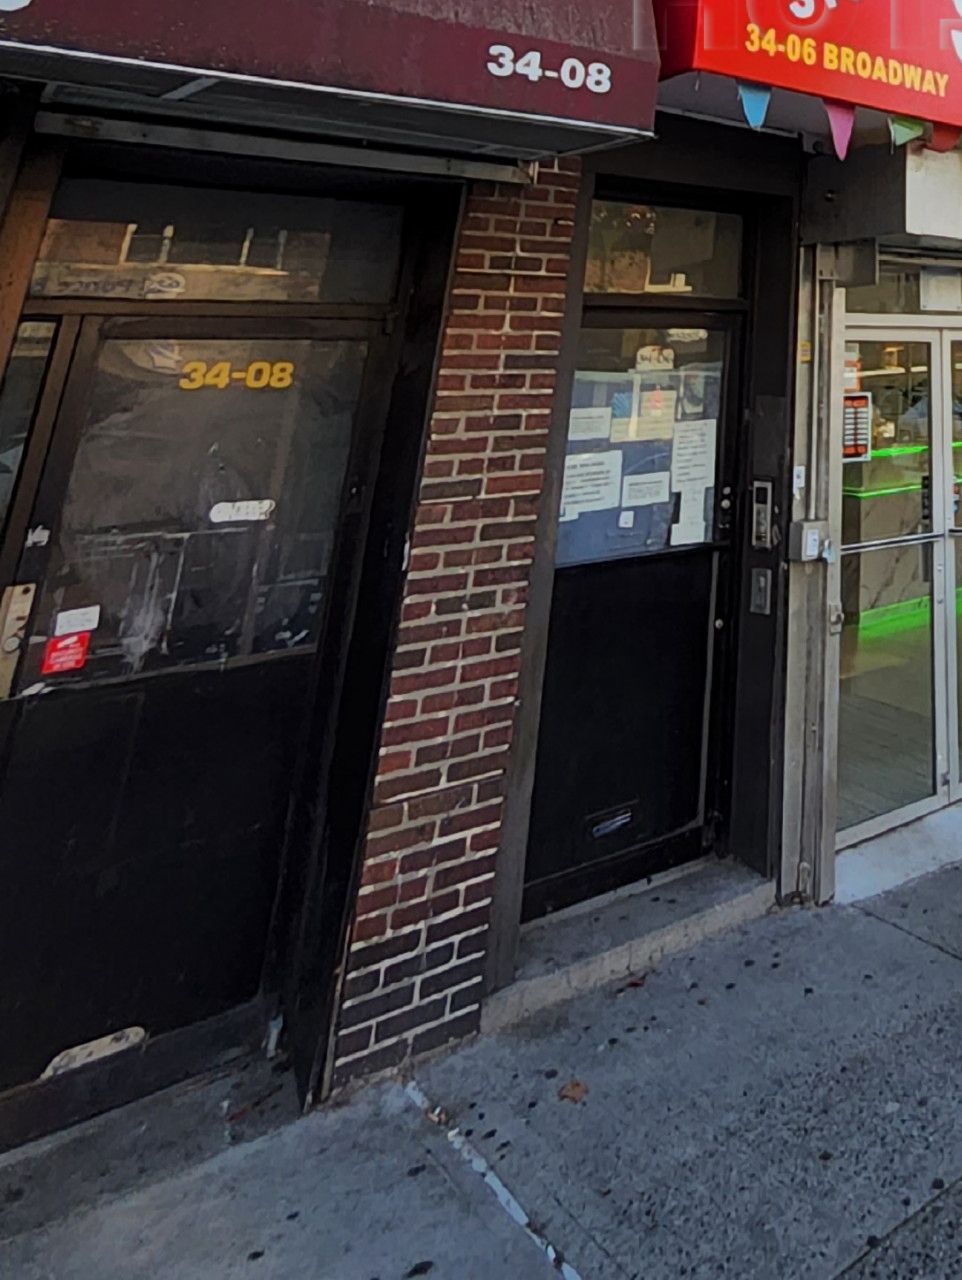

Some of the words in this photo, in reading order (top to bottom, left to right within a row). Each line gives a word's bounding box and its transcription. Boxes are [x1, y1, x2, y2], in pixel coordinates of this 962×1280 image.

[486, 44, 612, 94] 34-08
[745, 23, 817, 66] 34-06
[823, 41, 949, 97] BROADWAY
[178, 361, 295, 390] 34-08
